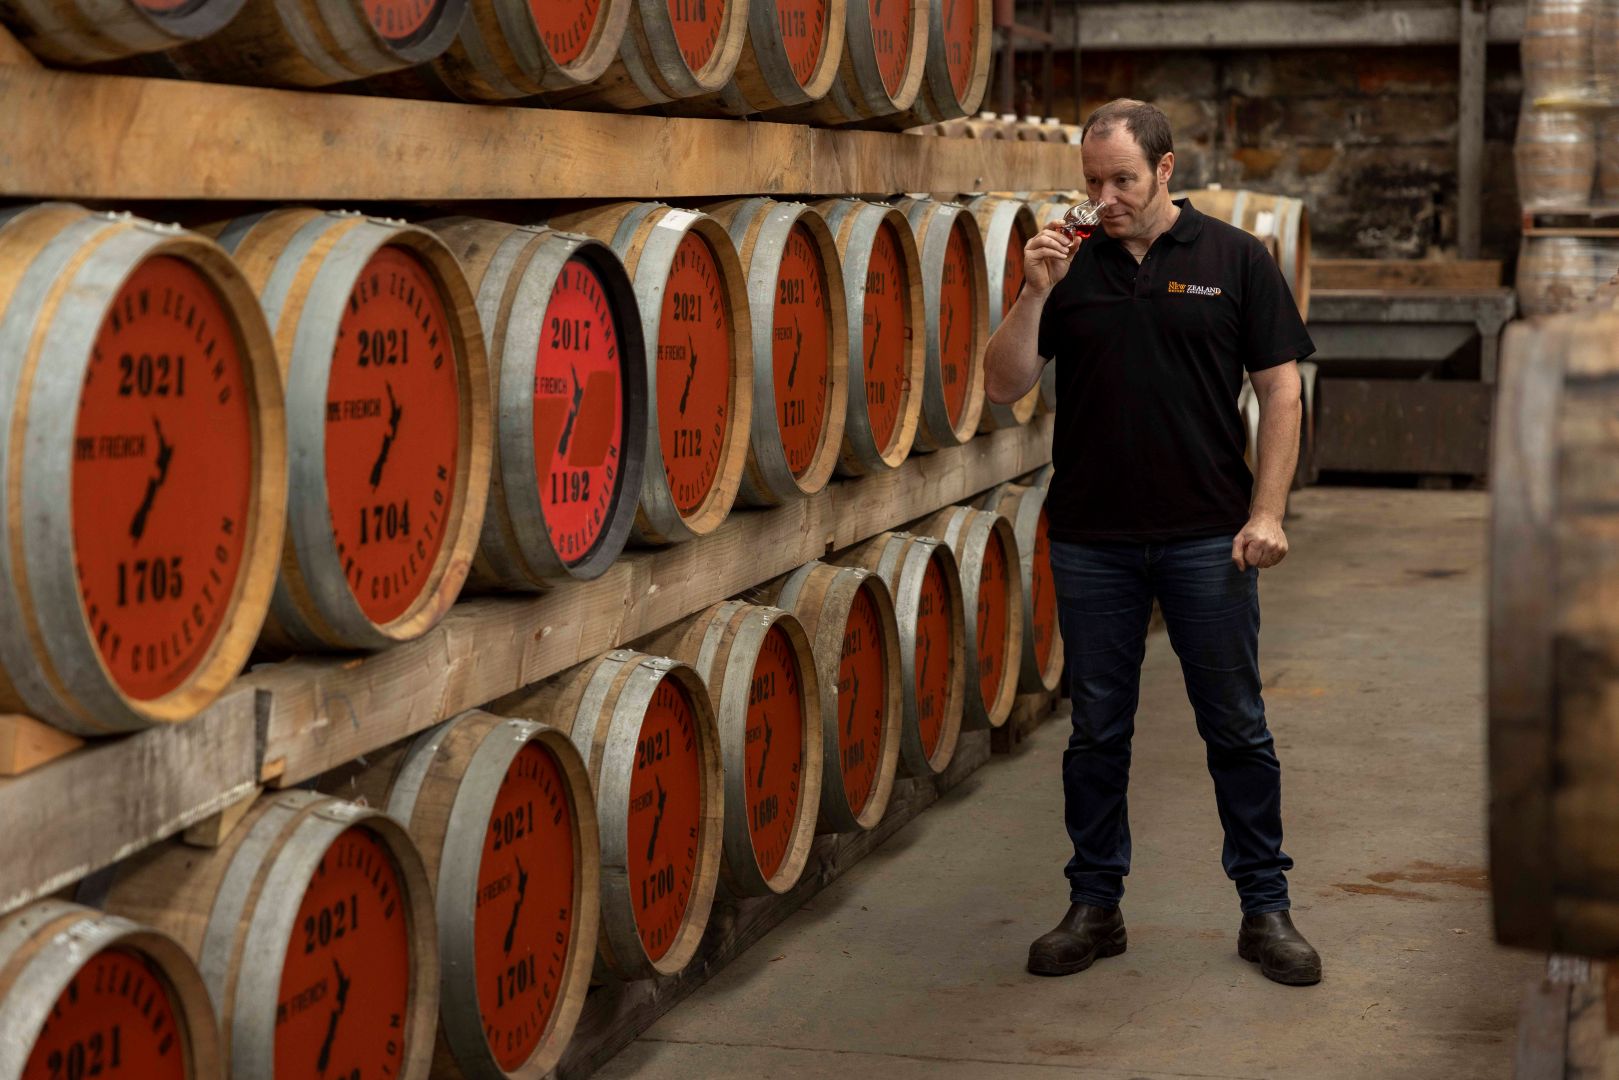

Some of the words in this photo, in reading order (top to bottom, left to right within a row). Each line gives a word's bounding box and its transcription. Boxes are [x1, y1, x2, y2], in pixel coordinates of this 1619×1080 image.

[673, 291, 702, 322] 2021
[780, 278, 805, 305] 2021
[1187, 284, 1222, 295] ZEALAND
[389, 271, 444, 370] ZEALAND
[551, 316, 592, 353] 2017
[163, 286, 231, 405] ZEALAND
[357, 328, 408, 368] 2021
[119, 353, 185, 397] 2021
[344, 398, 382, 420] FRENCH
[783, 398, 805, 428] 1711
[99, 435, 146, 460] FRENCH
[673, 428, 702, 458] 1712
[551, 470, 590, 505] 1192
[360, 498, 410, 545] 1704
[371, 464, 448, 599] COLLECTION
[117, 556, 183, 608] 1705
[130, 516, 234, 673] COLLECTION
[750, 670, 776, 706] 2021
[638, 726, 671, 771] 2021
[493, 800, 533, 852] 2021
[642, 862, 675, 910] 1700
[304, 892, 358, 955] 2021
[497, 953, 536, 1009] 1701
[46, 1023, 121, 1080] 2021
